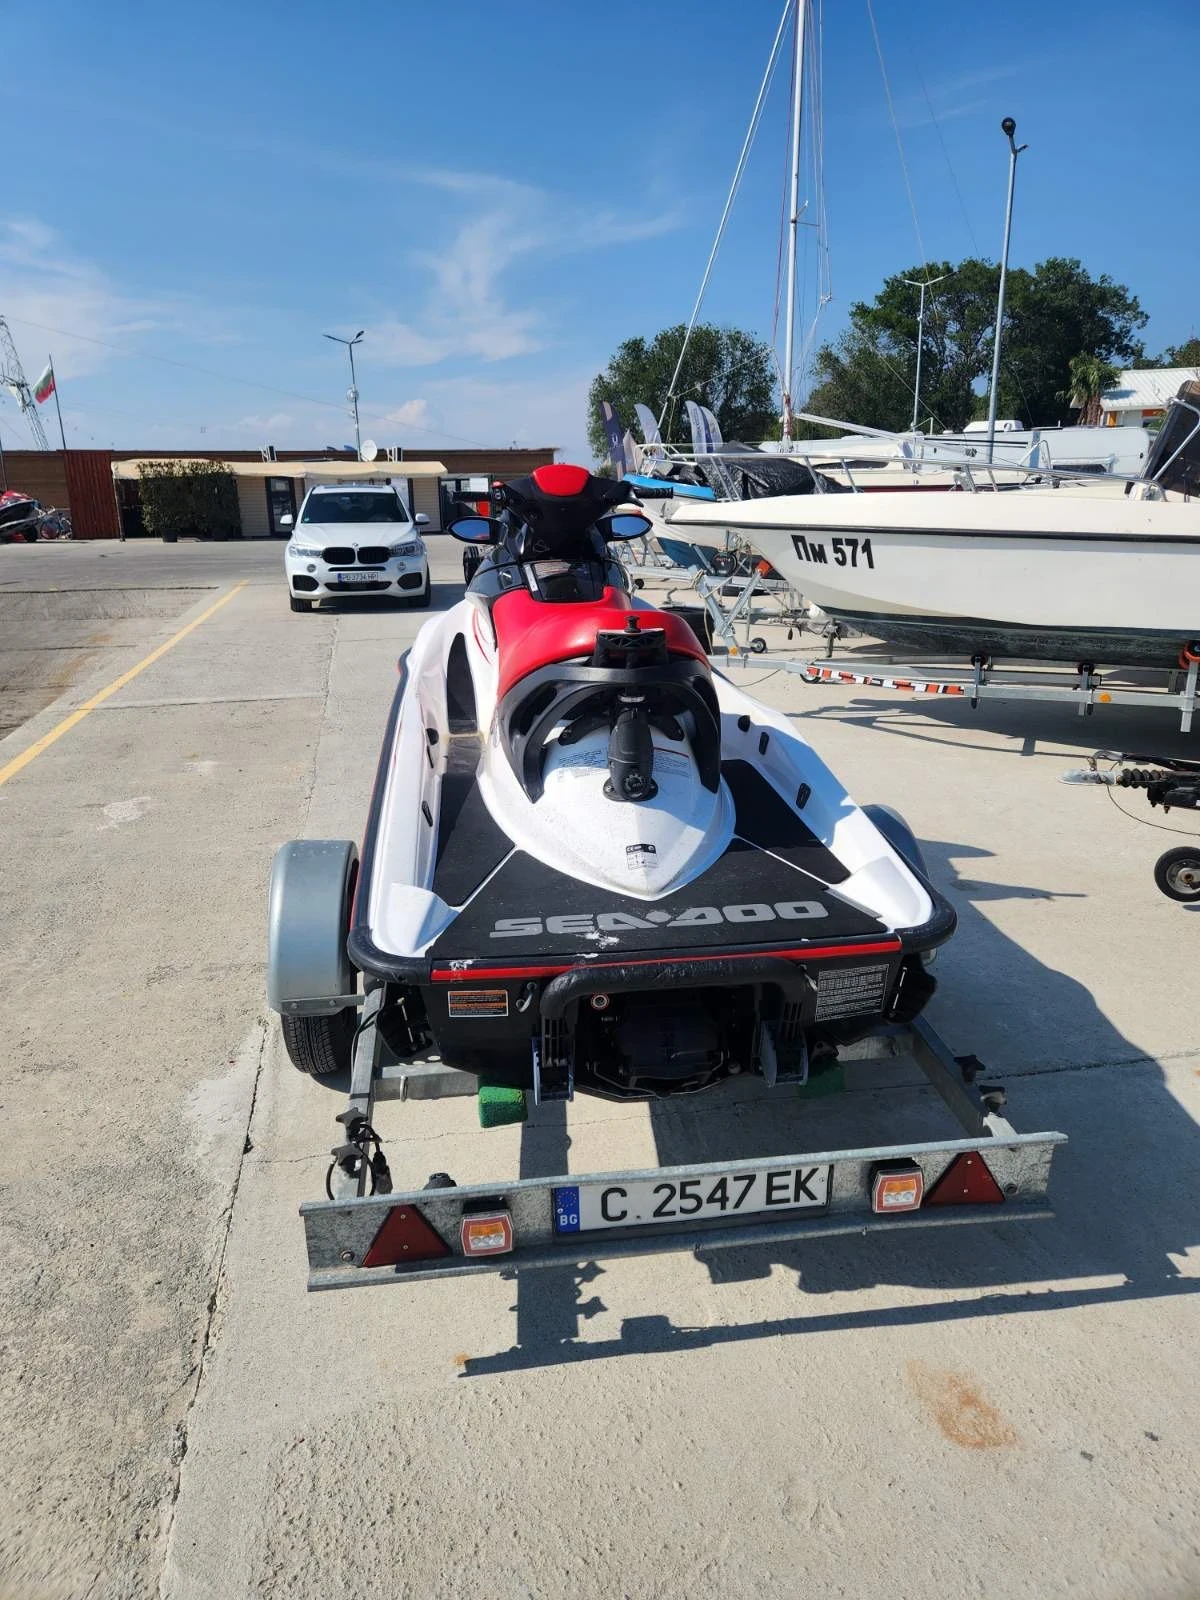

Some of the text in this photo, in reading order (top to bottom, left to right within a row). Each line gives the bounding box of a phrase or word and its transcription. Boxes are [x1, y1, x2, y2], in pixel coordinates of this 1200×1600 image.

[791, 535, 875, 569] Пм 571
[653, 1174, 756, 1217] 2547
[765, 1167, 819, 1206] EK
[559, 1214, 578, 1226] BG
